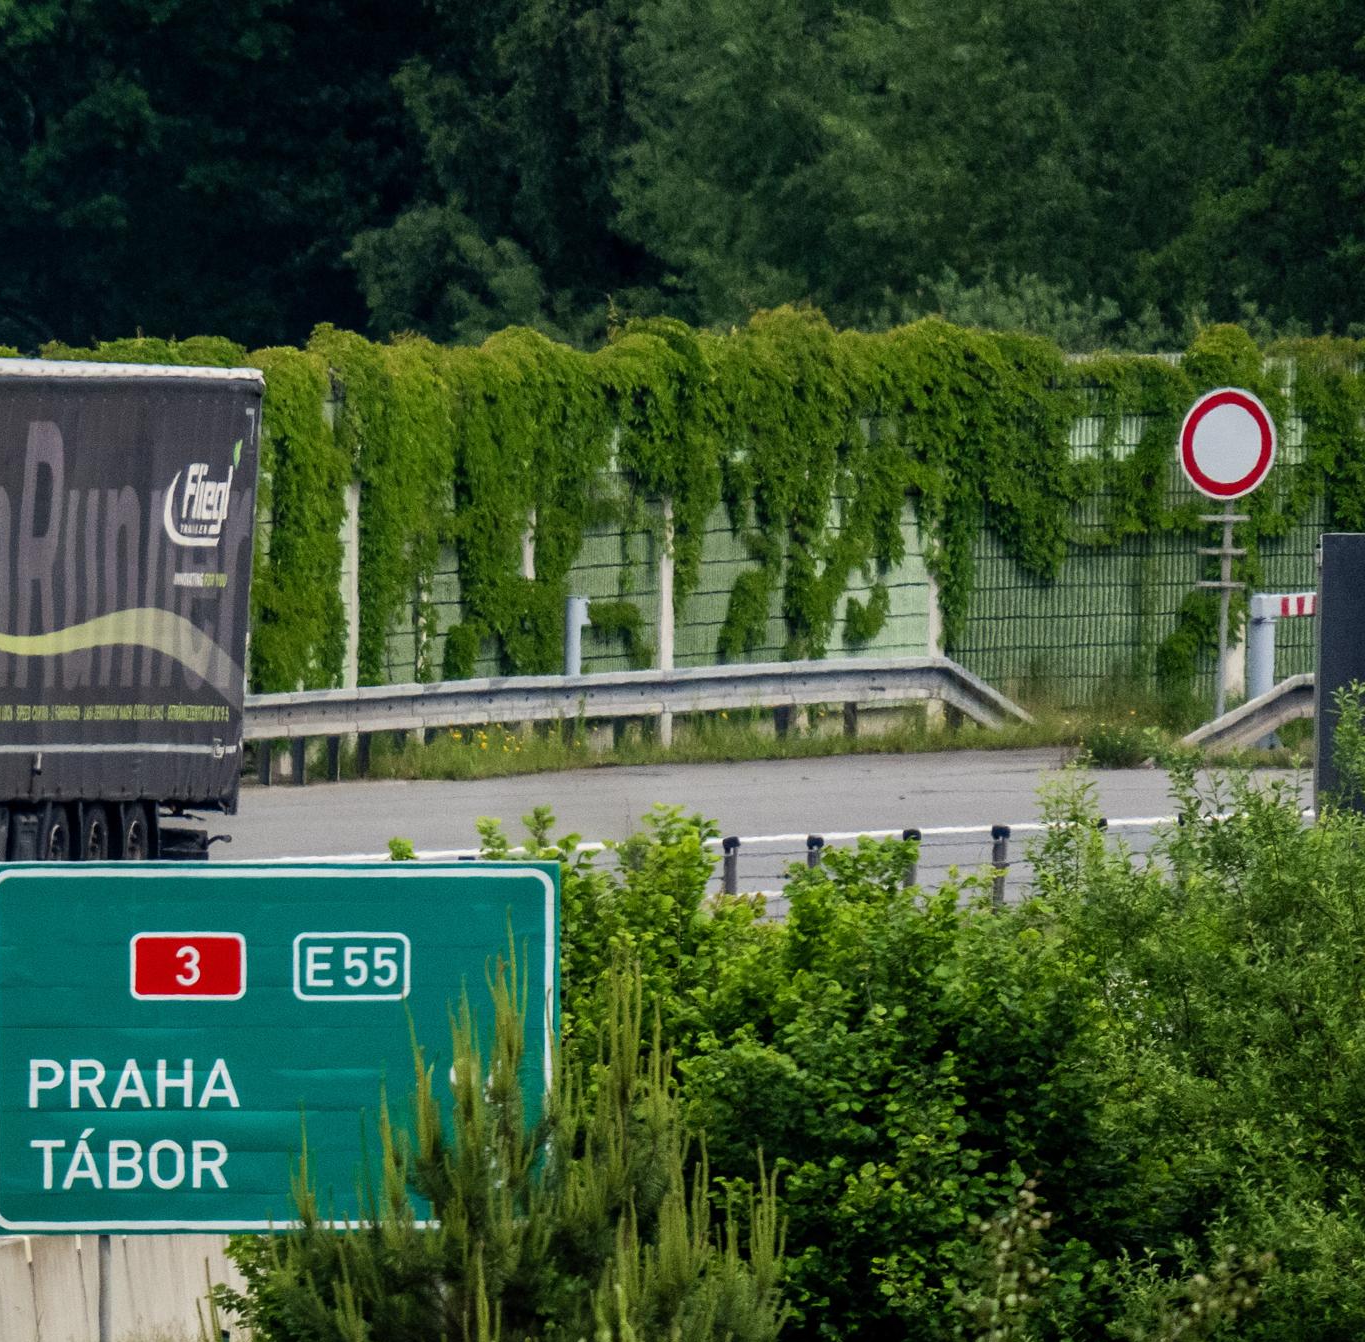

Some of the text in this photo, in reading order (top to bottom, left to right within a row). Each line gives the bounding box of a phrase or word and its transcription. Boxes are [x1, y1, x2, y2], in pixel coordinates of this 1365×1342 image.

[175, 945, 201, 986] 3
[28, 1057, 241, 1109] PRAHA
[29, 1126, 230, 1190] TÁBOR
